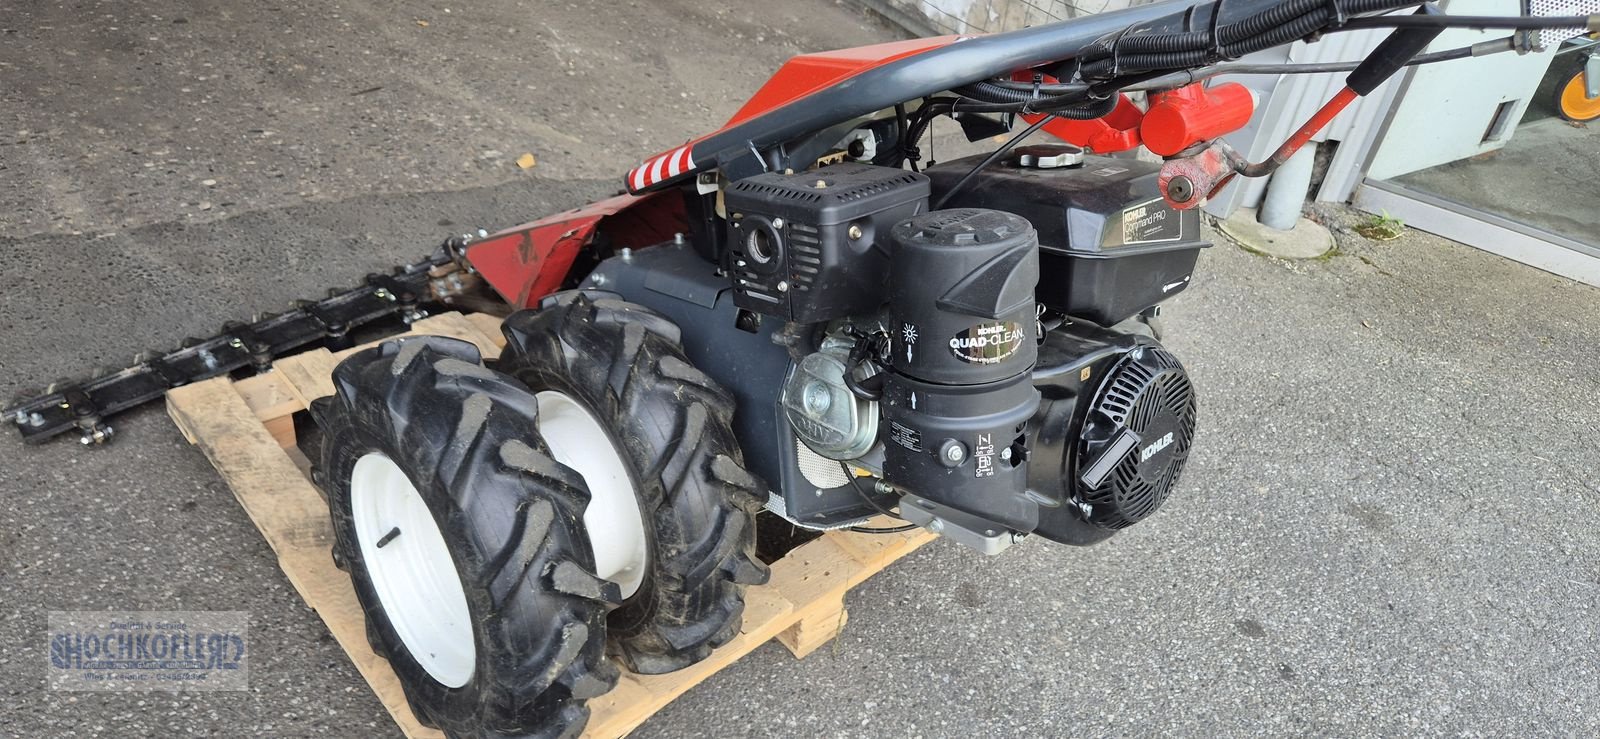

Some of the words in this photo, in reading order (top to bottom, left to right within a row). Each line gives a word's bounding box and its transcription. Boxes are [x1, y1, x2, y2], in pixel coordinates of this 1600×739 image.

[1124, 206, 1147, 223] KOHLER
[1124, 214, 1153, 233] Command
[1153, 209, 1166, 223] PRO
[949, 327, 1024, 349] QUAD-CLEAN
[977, 325, 1006, 336] KOHLER
[1141, 431, 1175, 463] KOHLER
